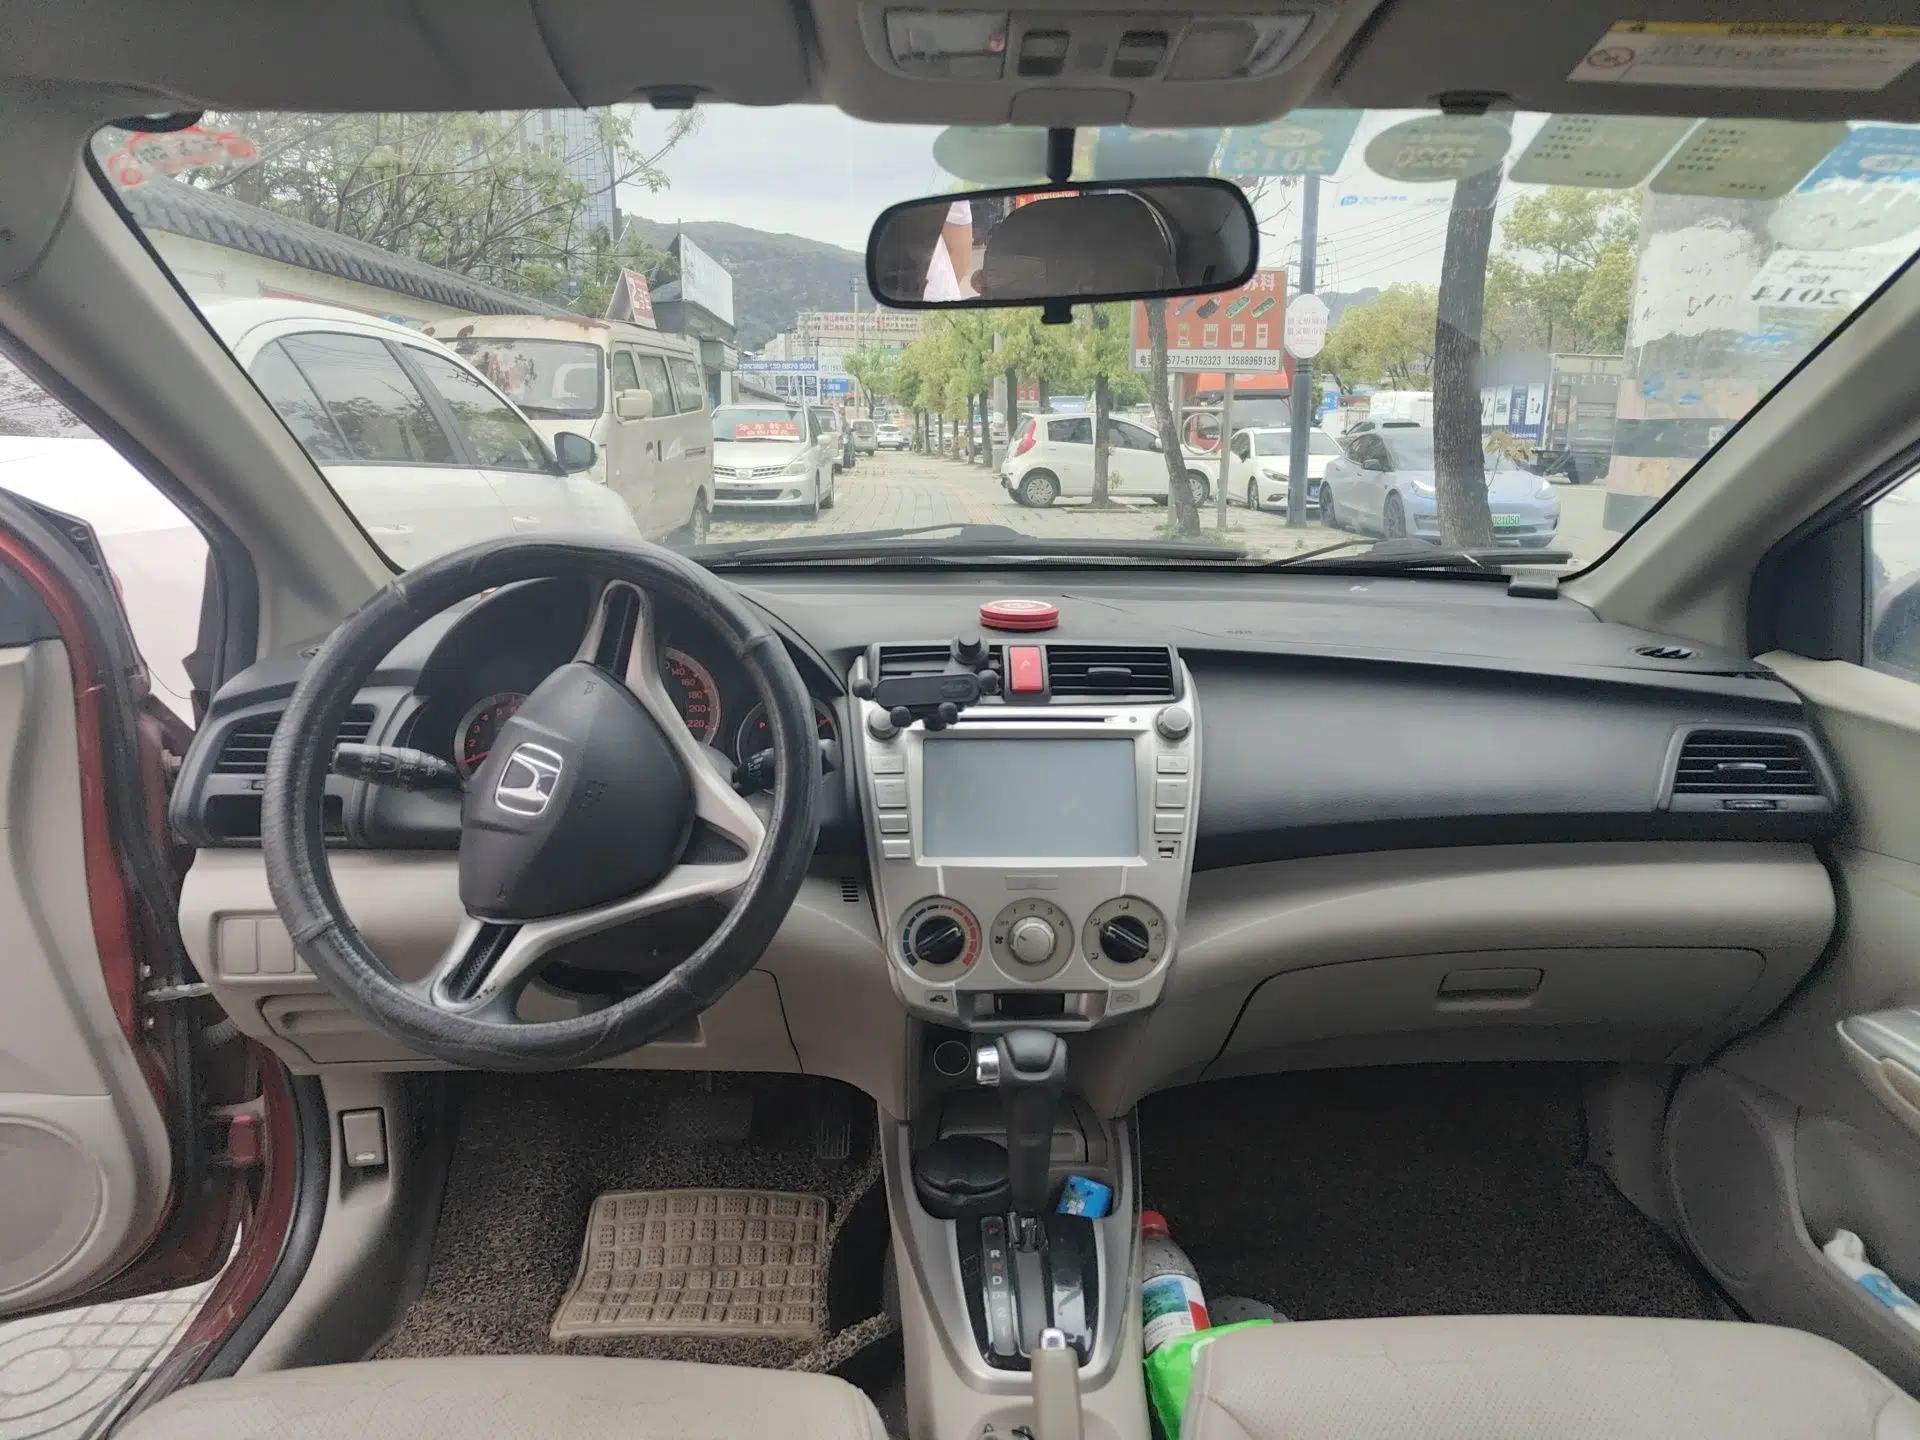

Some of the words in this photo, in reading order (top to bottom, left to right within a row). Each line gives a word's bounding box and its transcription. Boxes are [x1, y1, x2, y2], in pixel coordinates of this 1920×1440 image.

[687, 720, 704, 728] 220
[990, 1249, 1001, 1259] R
[992, 1275, 1003, 1285] D
